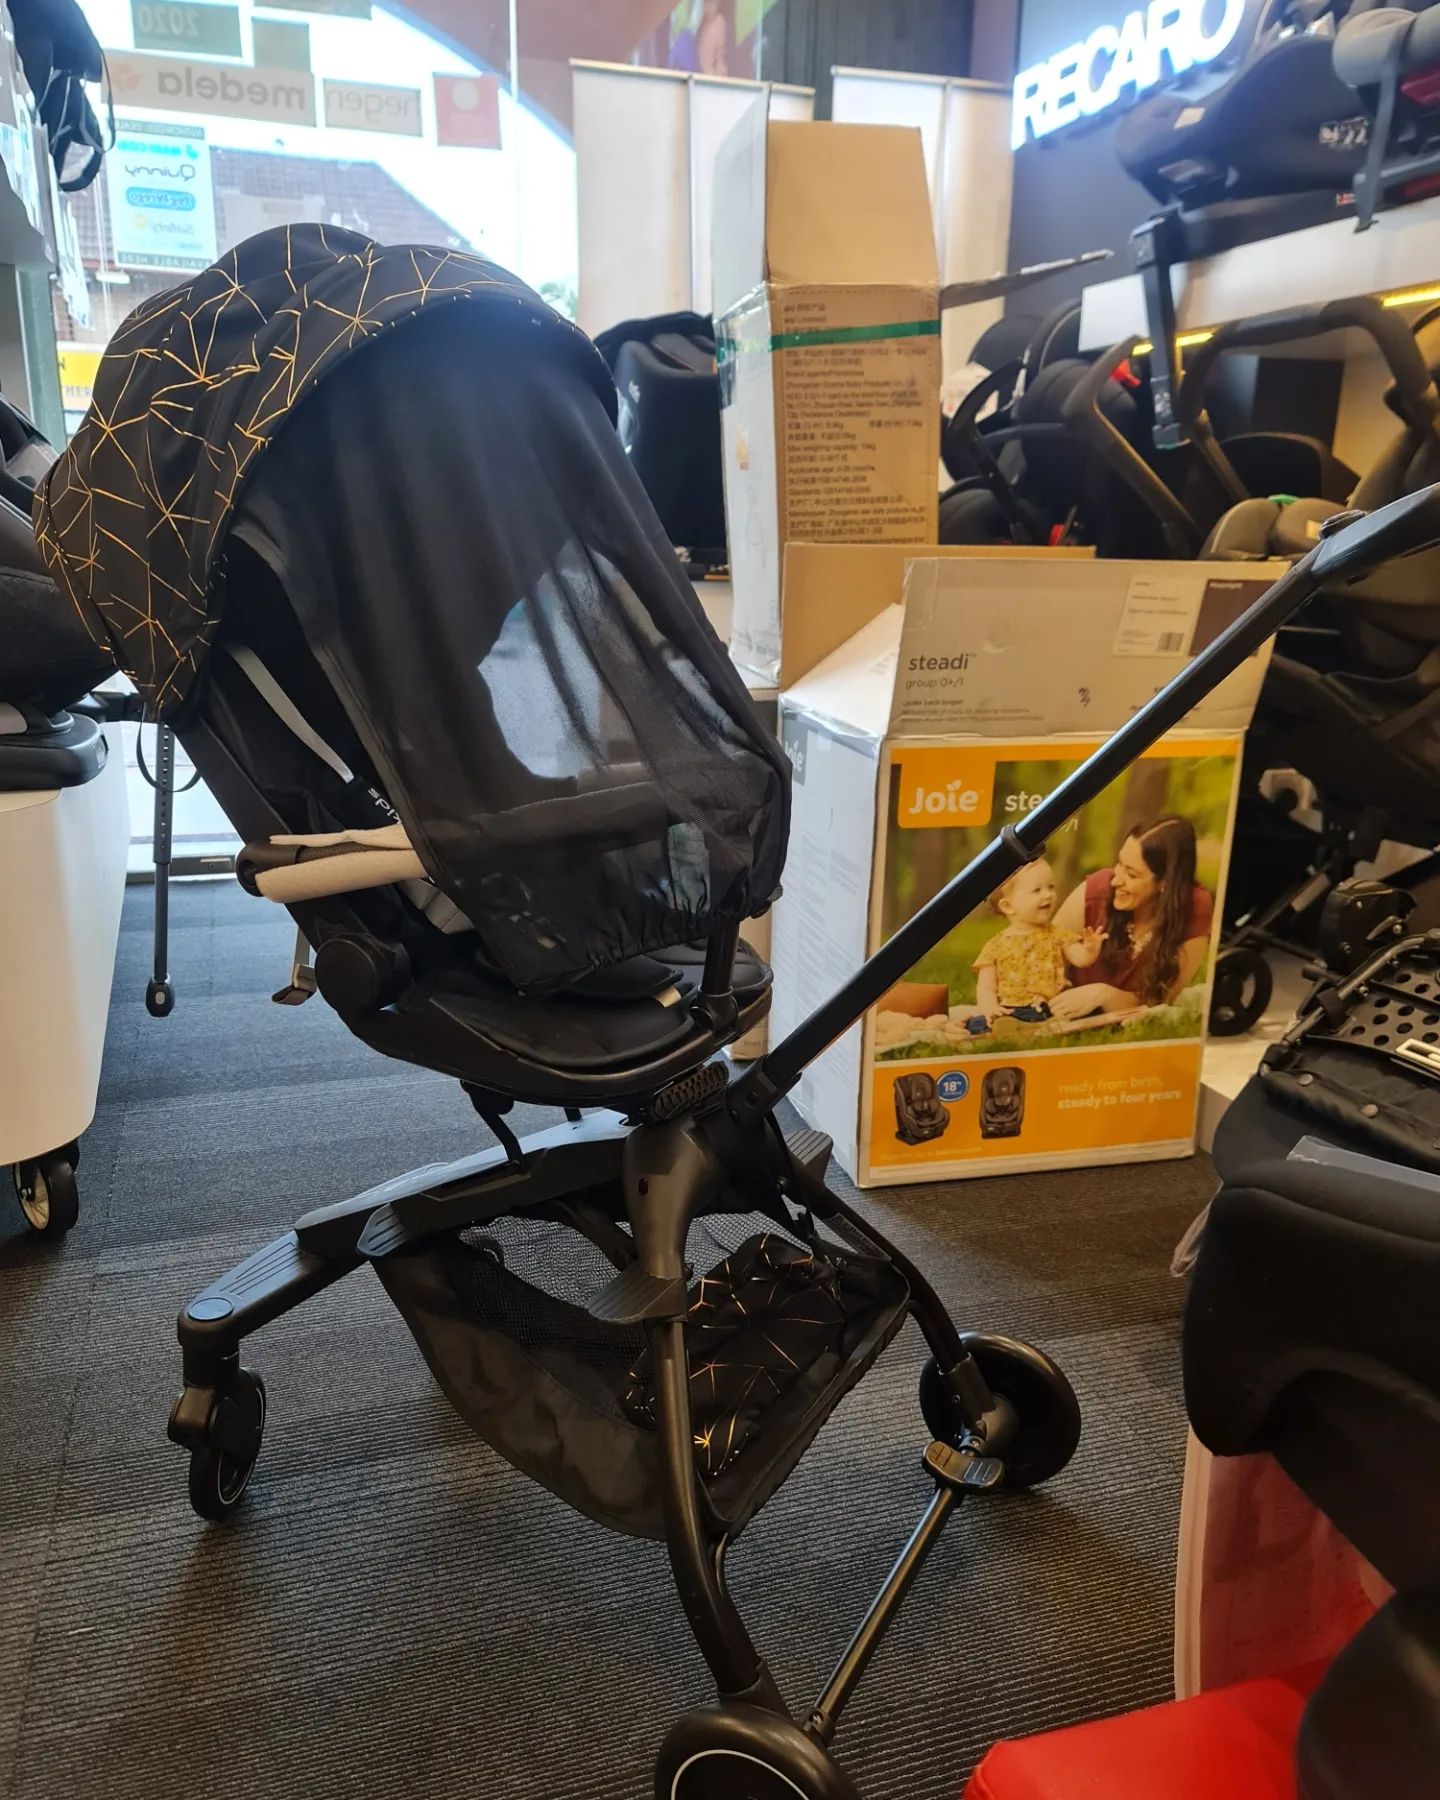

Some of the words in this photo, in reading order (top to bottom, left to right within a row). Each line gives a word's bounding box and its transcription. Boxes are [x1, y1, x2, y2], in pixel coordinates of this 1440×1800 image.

[1010, 0, 1246, 151] RECARO
[908, 653, 969, 671] steadi
[905, 679, 937, 690] group
[940, 677, 964, 688] 0+/1
[908, 779, 979, 815] Joie
[1004, 790, 1050, 813] ste
[1058, 1080, 1092, 1095] ready
[1098, 1078, 1128, 1091] from
[1130, 1076, 1163, 1088] birth,
[1058, 1094, 1101, 1109] steady
[1103, 1095, 1118, 1105] to
[1120, 1091, 1147, 1104] four
[1148, 1089, 1182, 1103] years
